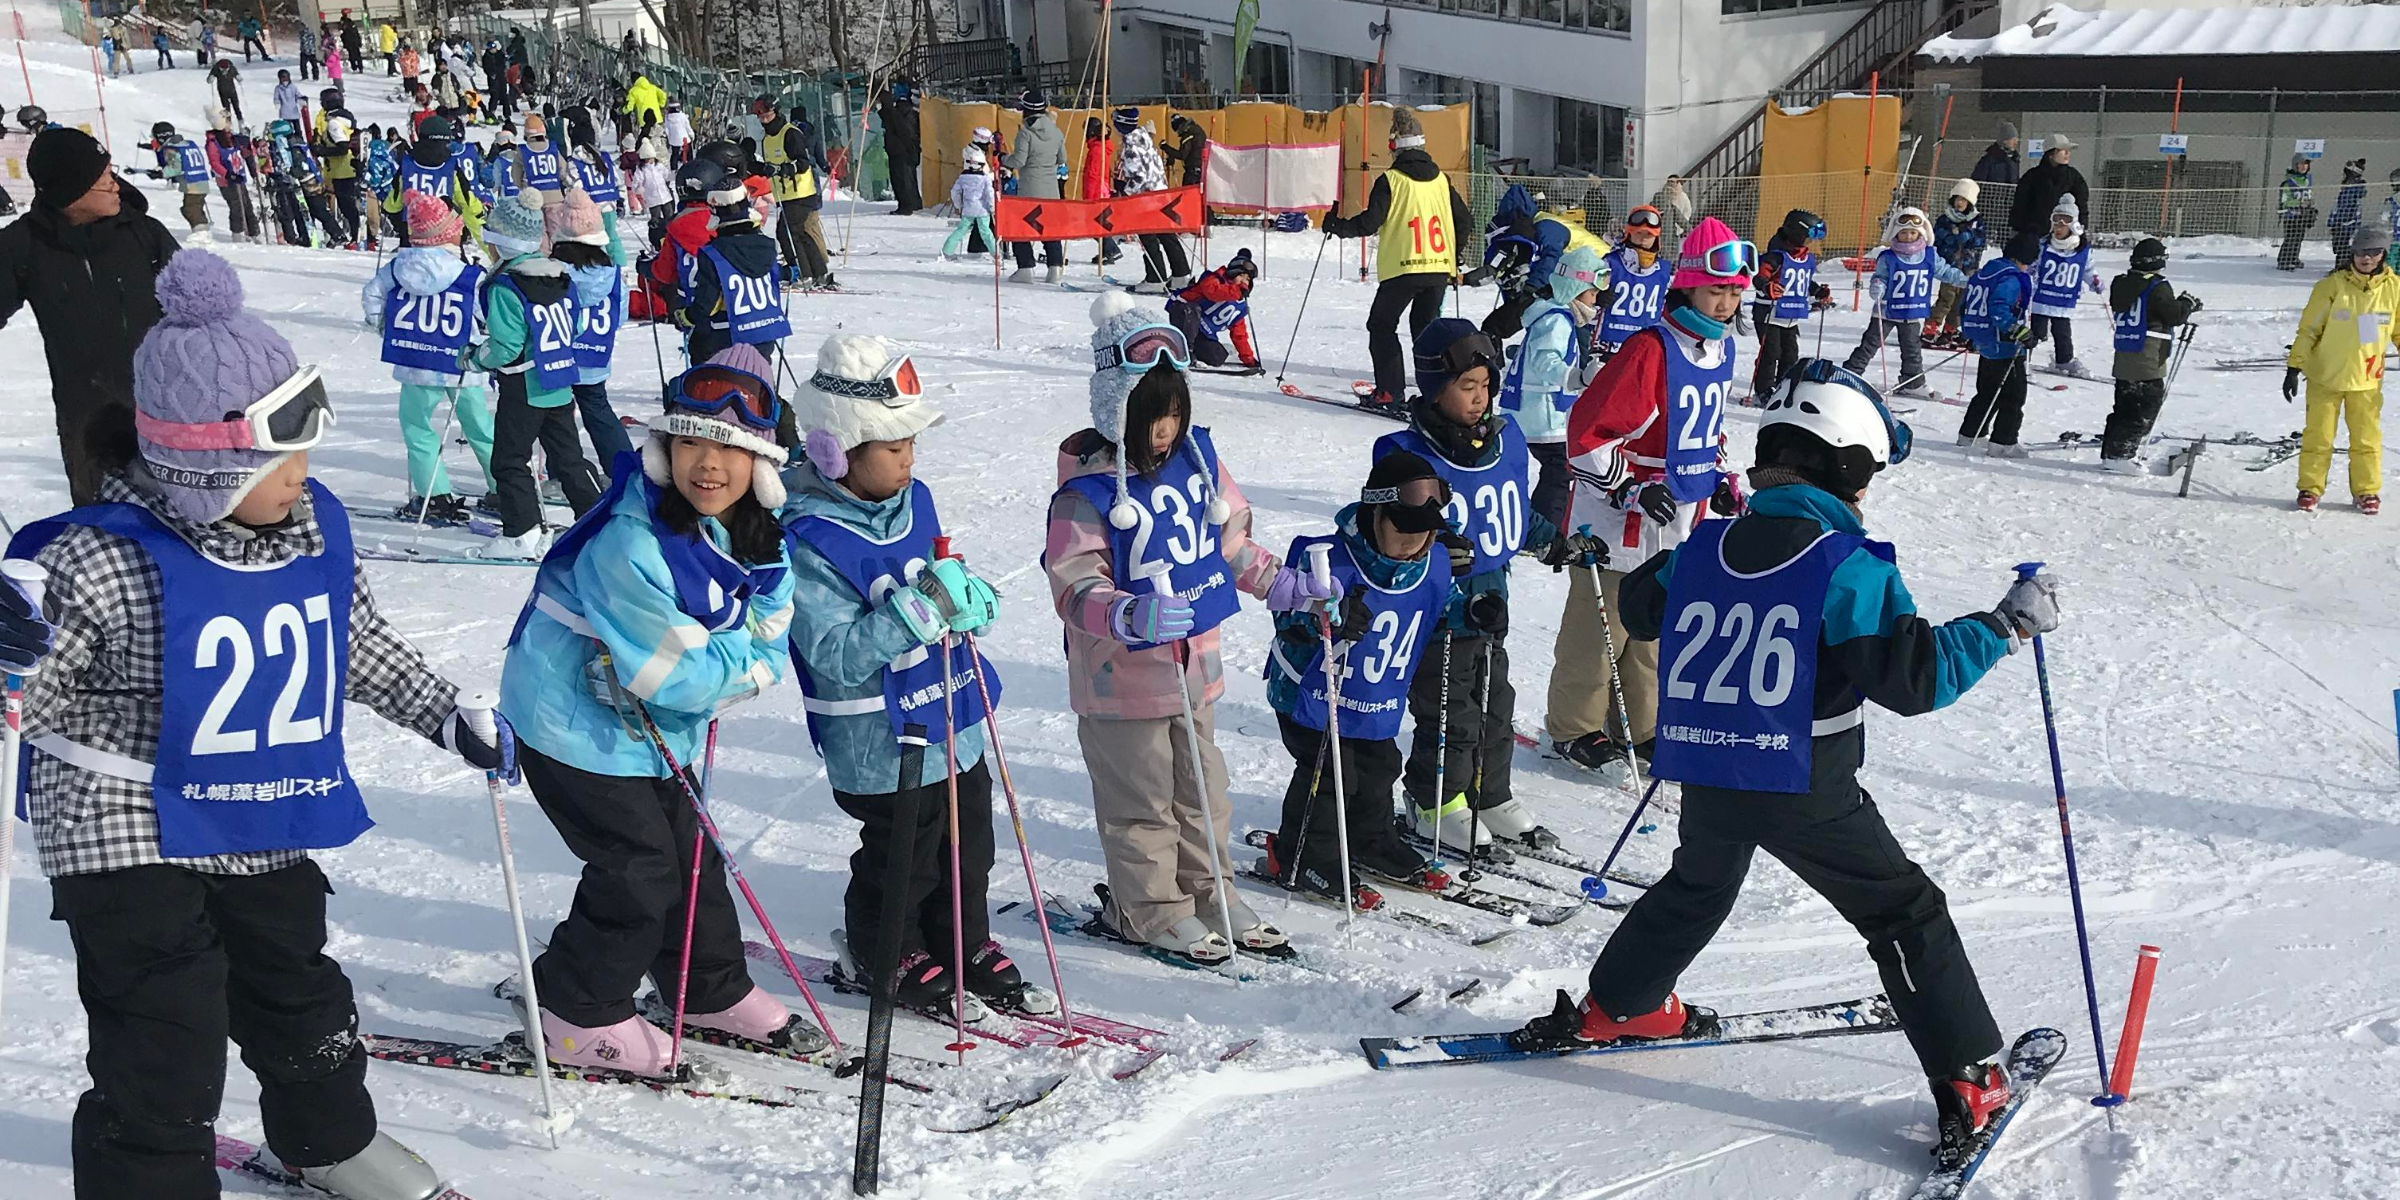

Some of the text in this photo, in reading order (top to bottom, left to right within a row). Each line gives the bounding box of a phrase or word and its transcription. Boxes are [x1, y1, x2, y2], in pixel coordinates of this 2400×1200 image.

[528, 155, 556, 176] 150
[408, 173, 449, 197] 154
[1408, 216, 1446, 254] 16
[1783, 268, 1811, 297] 281
[1893, 270, 1929, 298] 275
[2042, 260, 2080, 289] 280
[394, 287, 463, 337] 205
[1611, 281, 1660, 319] 284
[173, 472, 207, 487] LOVE
[212, 474, 252, 488] SUGE
[1129, 478, 1215, 582] 232
[1667, 600, 1800, 707] 226
[191, 593, 337, 756] 227
